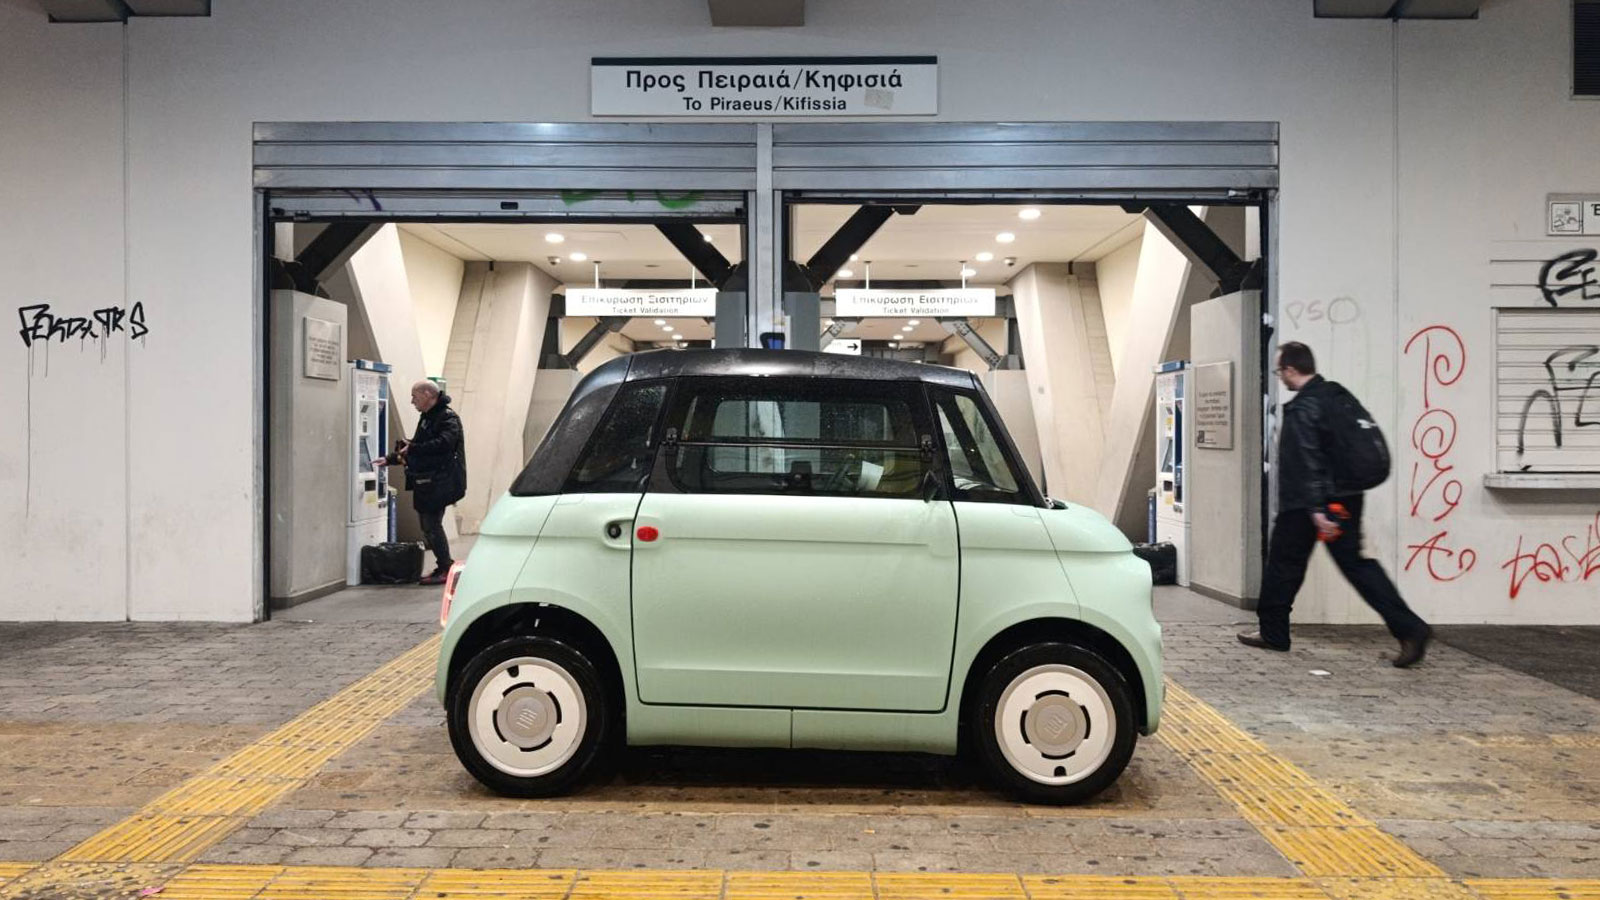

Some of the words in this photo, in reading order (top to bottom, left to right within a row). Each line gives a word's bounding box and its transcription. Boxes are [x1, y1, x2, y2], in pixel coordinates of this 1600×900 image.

[626, 70, 685, 93] Προς
[698, 69, 903, 92] Πειραιά/Κηφισιά
[683, 97, 702, 111] To
[711, 95, 847, 111] Piraeus/Kifissia
